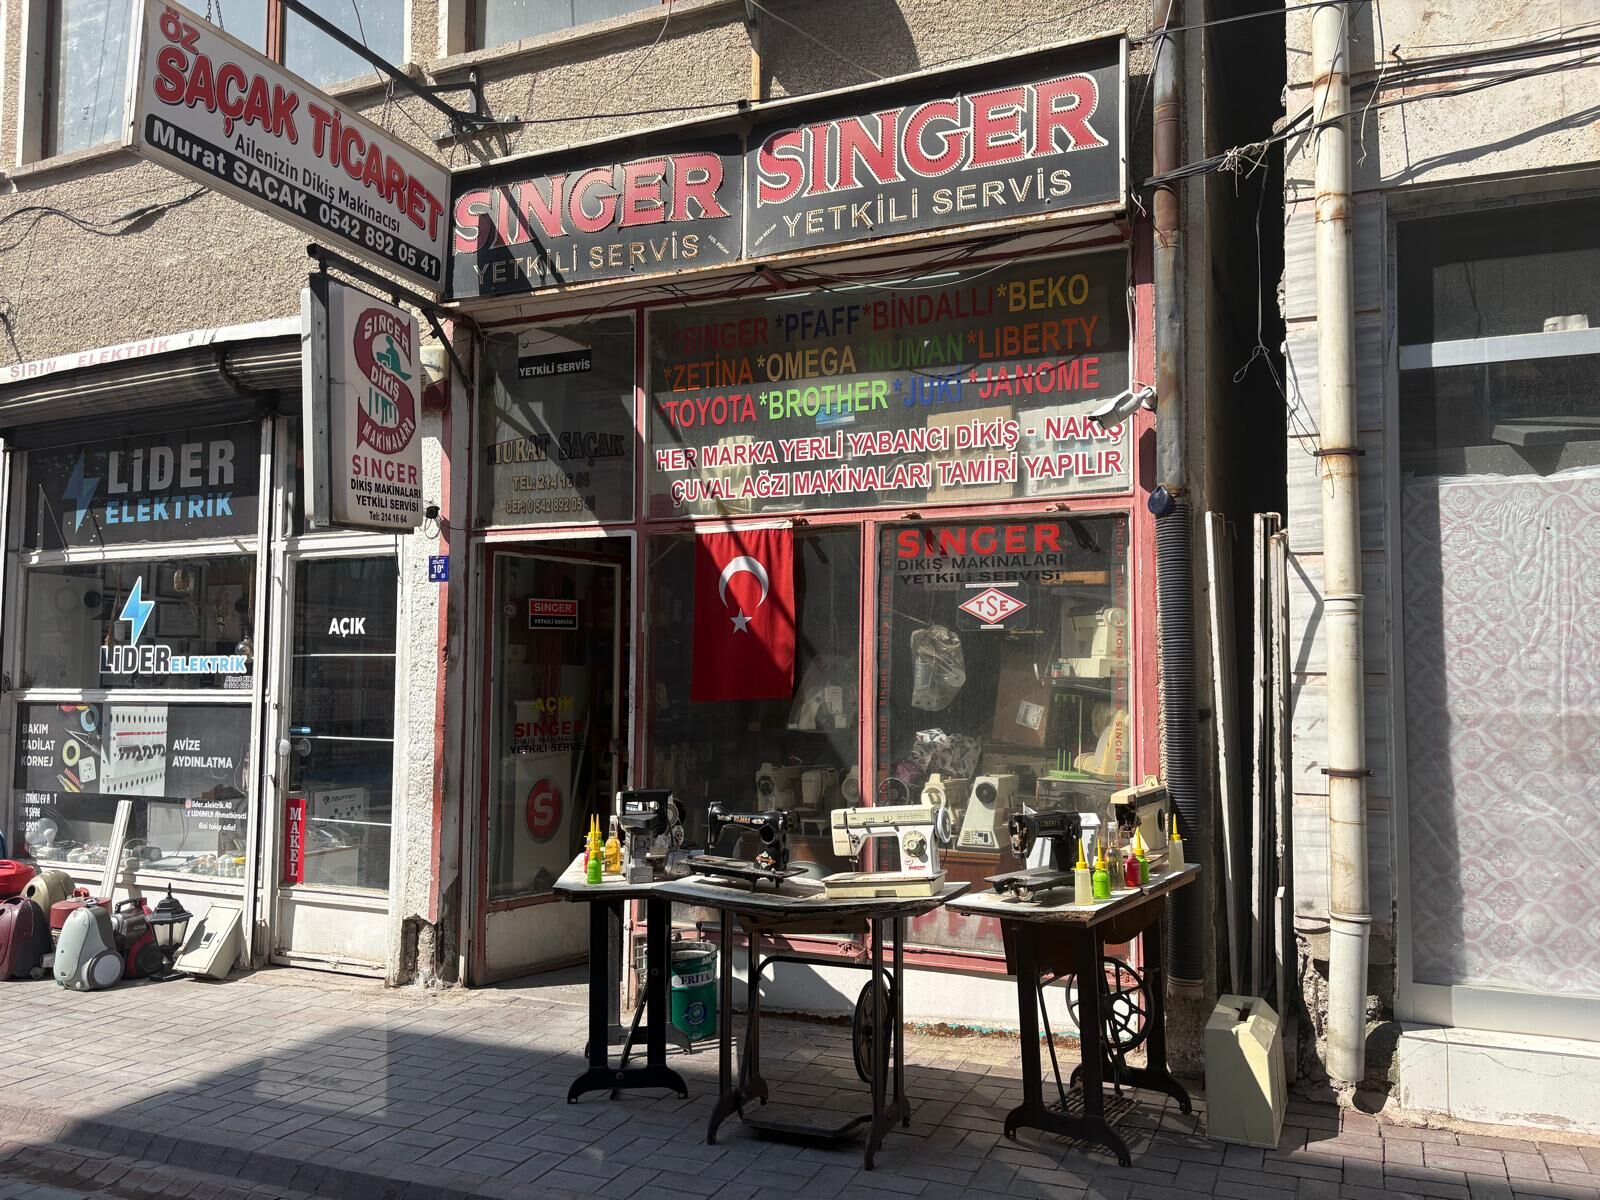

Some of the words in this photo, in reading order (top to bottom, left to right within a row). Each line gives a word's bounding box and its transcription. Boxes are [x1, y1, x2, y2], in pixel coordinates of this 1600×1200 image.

[160, 6, 200, 55] ÖZ
[153, 45, 299, 144] SAÇAK
[307, 102, 444, 242] TİCARET
[756, 72, 1109, 208] SINGER
[152, 120, 227, 175] Murat
[232, 161, 307, 214] SAÇAK
[319, 203, 360, 240] 0542
[365, 228, 394, 256] 892
[398, 244, 417, 266] 05
[420, 254, 437, 276] 41
[234, 134, 299, 183] Ailenizin
[302, 168, 335, 204] Dikiş
[338, 187, 400, 234] Makinacısı
[452, 152, 731, 255] SINGER
[783, 187, 918, 238] YETKİLİ
[932, 168, 1072, 215] SERVİS
[474, 244, 578, 284] YETKİLİ
[589, 231, 700, 270] SERVİS
[785, 305, 860, 342] PFAFF
[873, 286, 993, 331] BİNDALLI
[1009, 273, 1089, 312] BEKO
[364, 314, 410, 354] SINGER
[78, 339, 171, 367] ELEKTRİK
[519, 362, 555, 377] YETKİLİ
[556, 359, 590, 373] SERVİS
[673, 354, 754, 392] ZETİNA
[766, 345, 857, 382] OMEGA
[978, 315, 1099, 360] LIBERTY
[664, 393, 757, 427] TOYOTA
[769, 380, 889, 420] BROTHER
[978, 357, 1100, 399] JANOME
[362, 417, 416, 452] MAKİNALARI
[487, 433, 551, 465] MURAT
[558, 431, 625, 467] SAÇAK
[656, 447, 697, 472] HER
[702, 440, 778, 469] MARKA
[779, 430, 844, 463] YERLİ
[847, 426, 949, 458] YABANCI
[955, 416, 1020, 451] DİKİŞ
[1044, 415, 1125, 445] NAKŞ
[352, 454, 418, 485] SINGER
[512, 474, 537, 491] TEL:
[671, 478, 737, 508] ÇUVAL
[741, 470, 790, 498] AĞZI
[793, 462, 931, 495] MAKİNALARI
[937, 453, 1018, 486] TAMİRİ
[1023, 449, 1125, 480] YAPILIR
[351, 476, 373, 493] DİKİŞ
[374, 483, 421, 499] MAKİNALARI
[356, 494, 388, 509] YETKİLİ
[390, 499, 419, 512] SERVİSİ
[105, 491, 233, 524] ELEKTRİK
[369, 510, 380, 521] Tel:
[381, 512, 391, 521] 214
[897, 523, 1063, 559] SINGER
[897, 557, 943, 572] DİKİŞ
[951, 554, 1064, 569] MAKİNALARI
[901, 572, 972, 585] YETKİLİ
[979, 570, 1061, 582] SERVİSİ
[976, 595, 1009, 617] TSE
[328, 617, 366, 637] AÇIK
[171, 655, 247, 673] ELEKTRİK
[534, 696, 576, 715] AÇIK
[21, 737, 56, 751] TADİLAT
[22, 723, 49, 735] BAKIM
[173, 737, 201, 751] AVİZE
[514, 720, 585, 738] SINGER
[1115, 721, 1123, 761] SINGER
[21, 755, 54, 767] KORNEJ
[172, 755, 233, 769] AYDINLATMA
[533, 792, 554, 826] S
[290, 807, 302, 877] MAKEL
